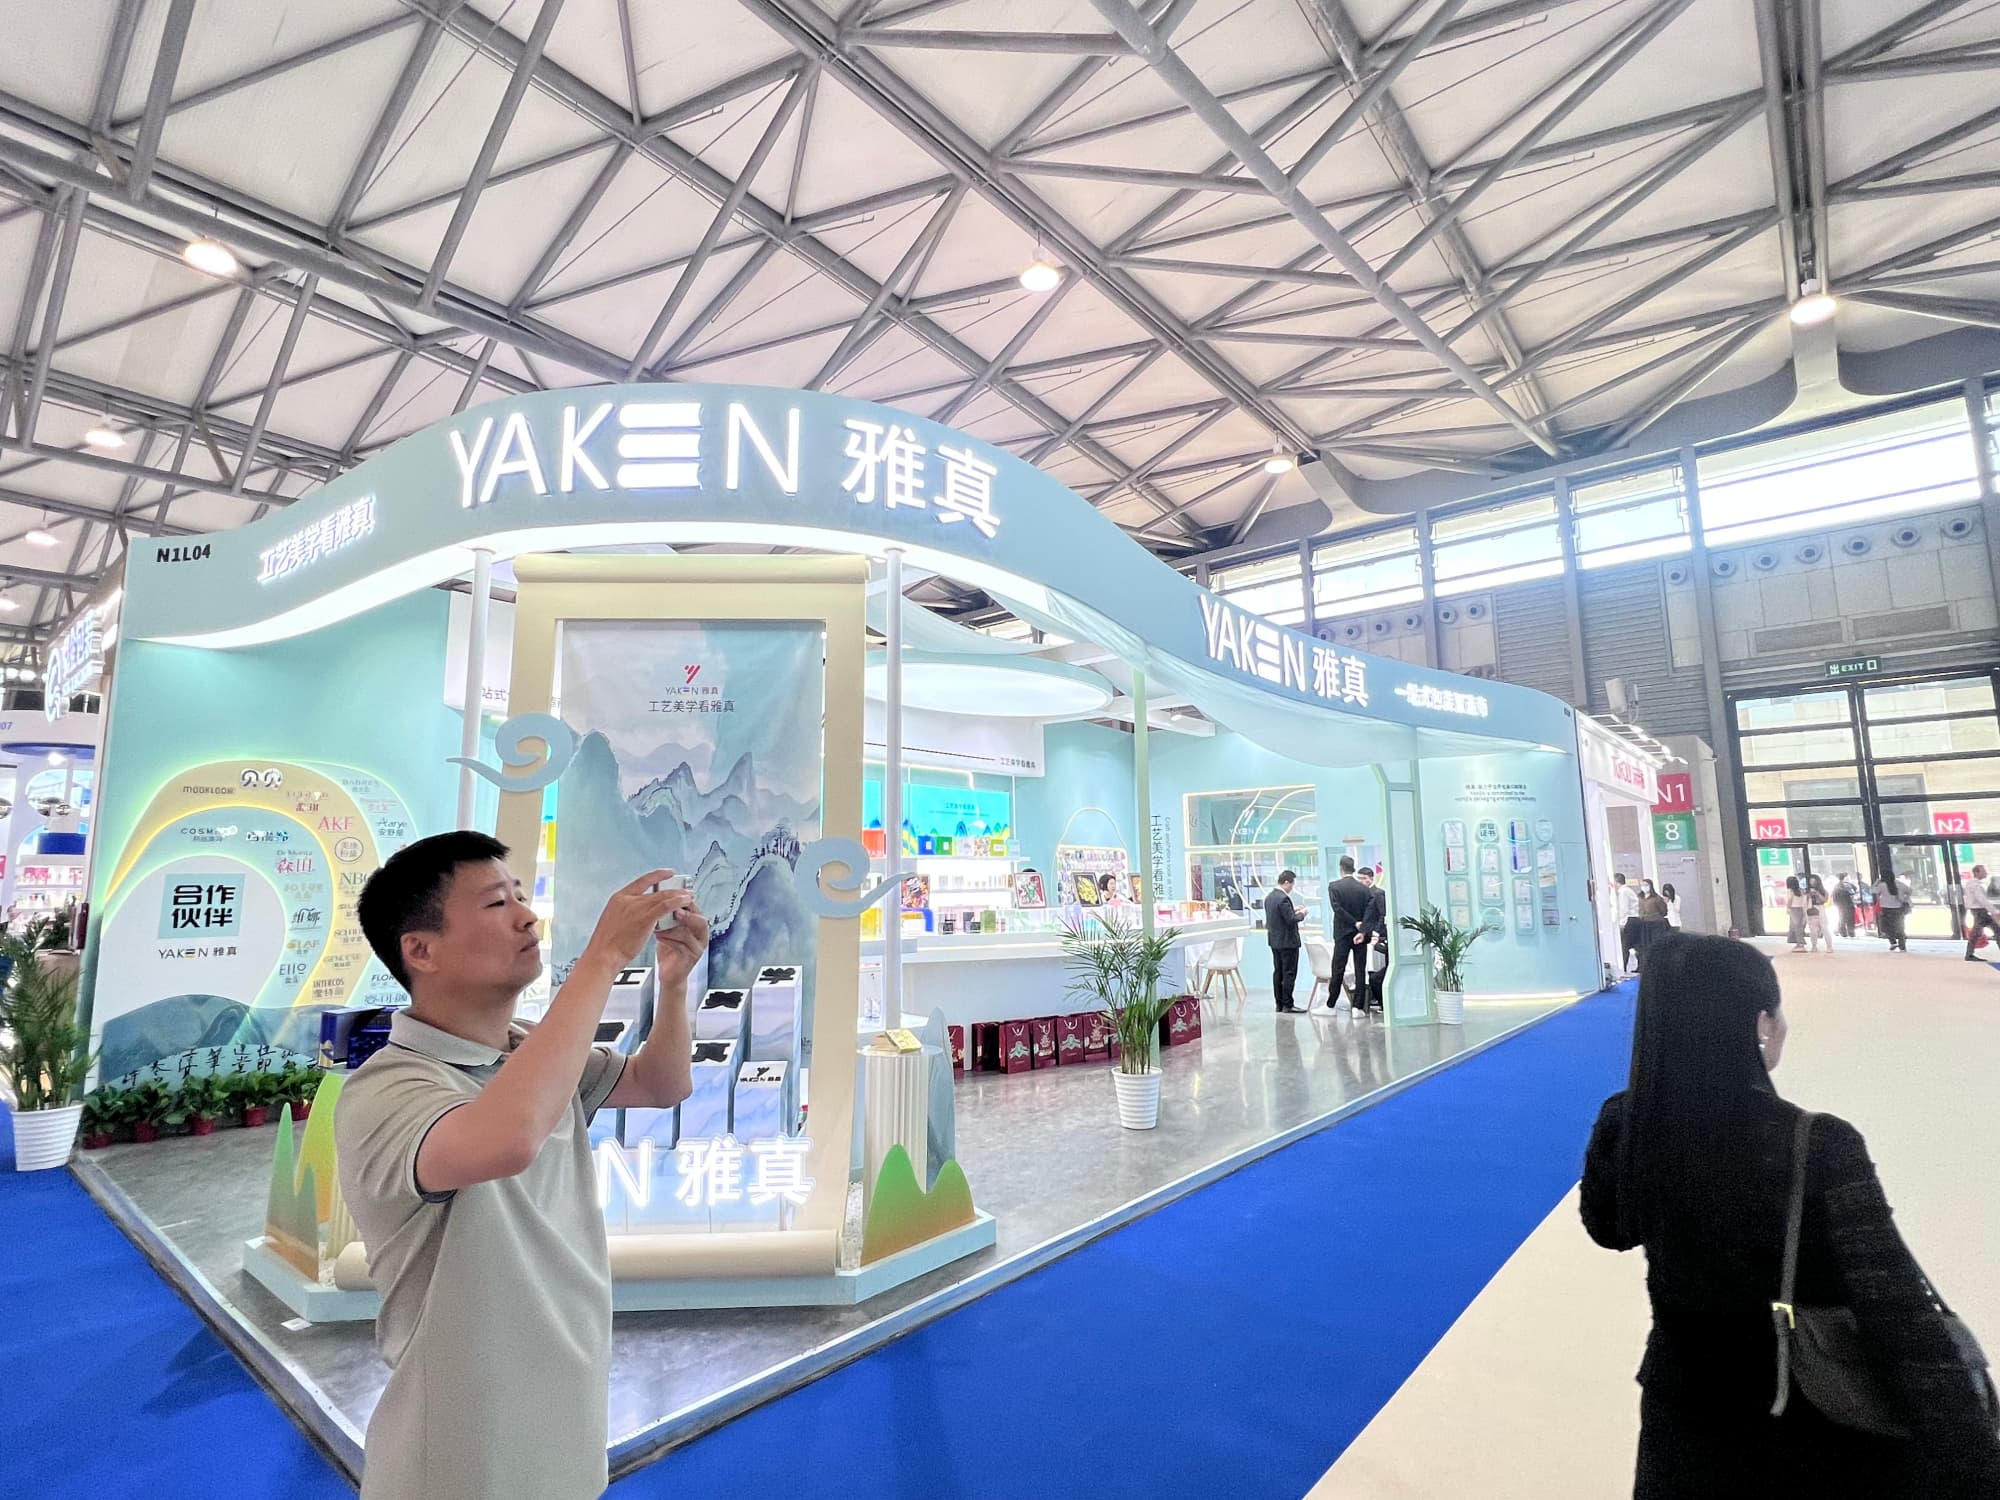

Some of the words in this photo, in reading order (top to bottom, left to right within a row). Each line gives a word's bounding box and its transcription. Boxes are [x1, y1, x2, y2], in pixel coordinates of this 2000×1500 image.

[449, 400, 800, 509] YAKEN
[841, 417, 1001, 538] 雅真
[156, 543, 211, 563] N1L04
[1199, 592, 1307, 692] YAKEN
[1312, 645, 1369, 708] 雅真
[1841, 662, 1865, 672] EXIT
[665, 687, 699, 695] YAKEN
[648, 700, 735, 713] 工艺美学看雅真
[0, 721, 13, 731] 07
[1657, 782, 1686, 804] N1
[318, 815, 353, 831] AKF
[1664, 822, 1681, 841] 8
[1758, 824, 1783, 838] N2
[1936, 818, 1967, 833] N2
[1150, 815, 1164, 900] 工艺美学看雅
[173, 884, 236, 905] 合作
[172, 907, 233, 928] 伙伴
[158, 947, 209, 960] YAKEN
[675, 1133, 816, 1207] 雅真
